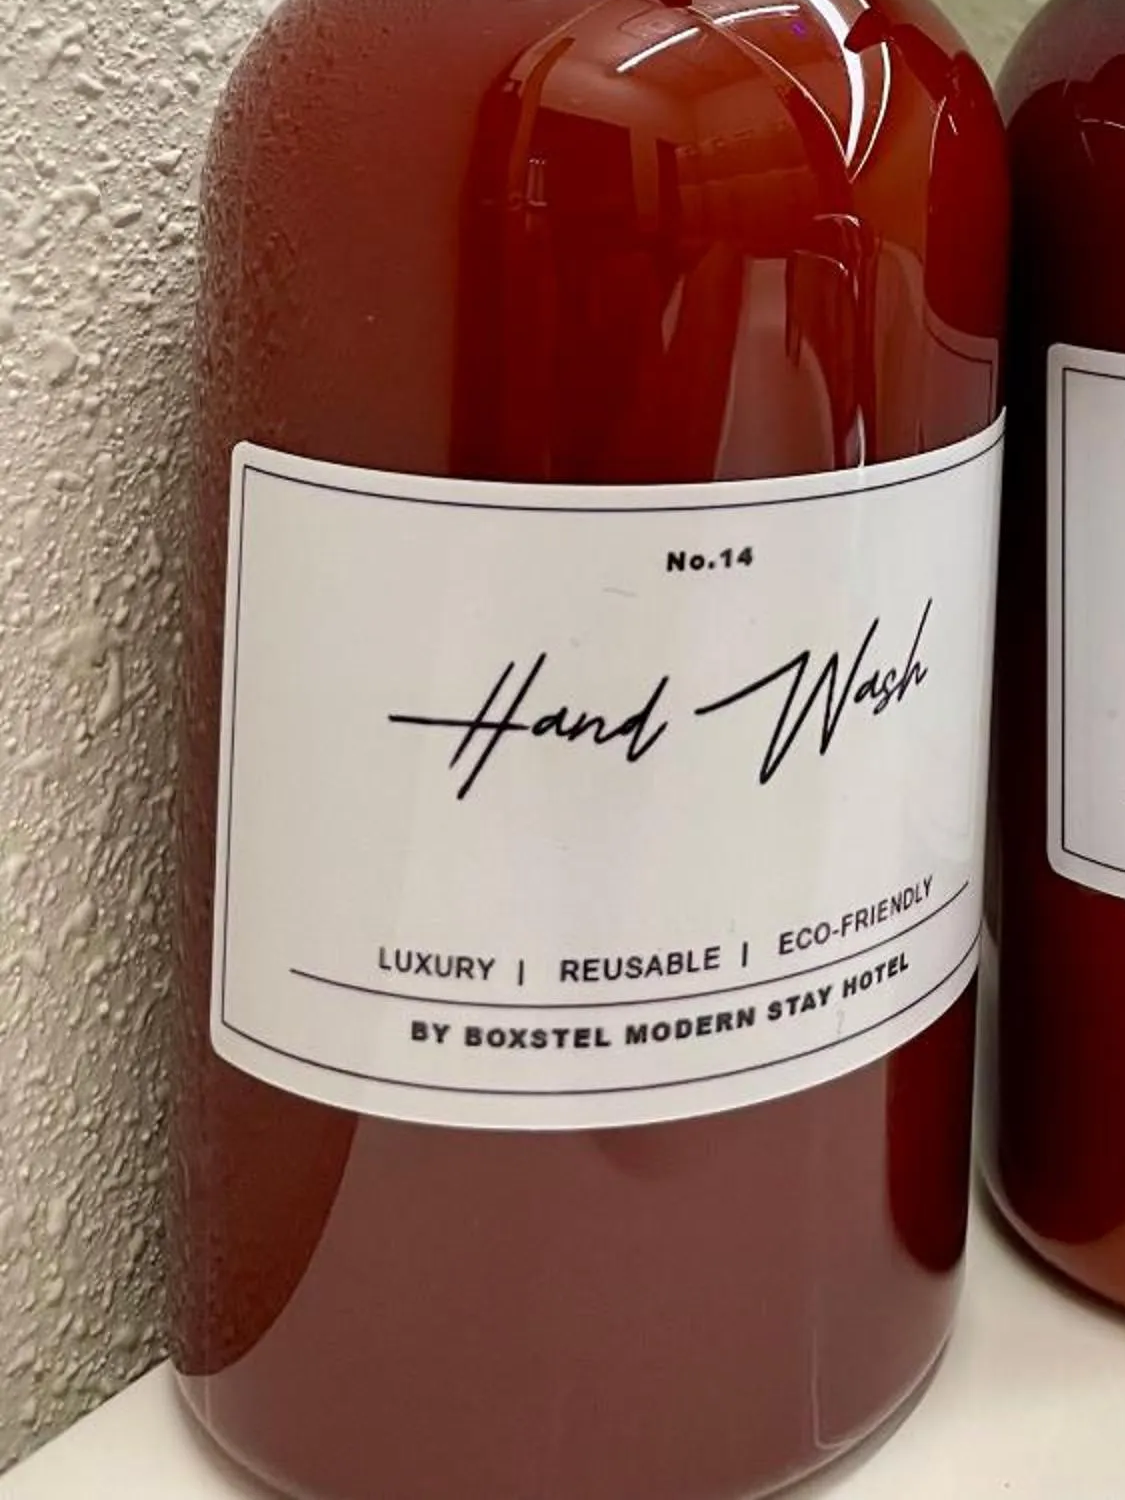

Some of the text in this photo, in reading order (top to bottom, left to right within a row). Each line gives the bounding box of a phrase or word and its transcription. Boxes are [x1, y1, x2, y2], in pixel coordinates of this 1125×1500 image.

[665, 545, 754, 573] No.14
[387, 597, 934, 802] Hand Wash
[378, 874, 933, 983] LUXURY REUSABLE ECO-FRIENDLY
[410, 951, 910, 1050] BY BOXSTEL MODERN STAY HOTEL
